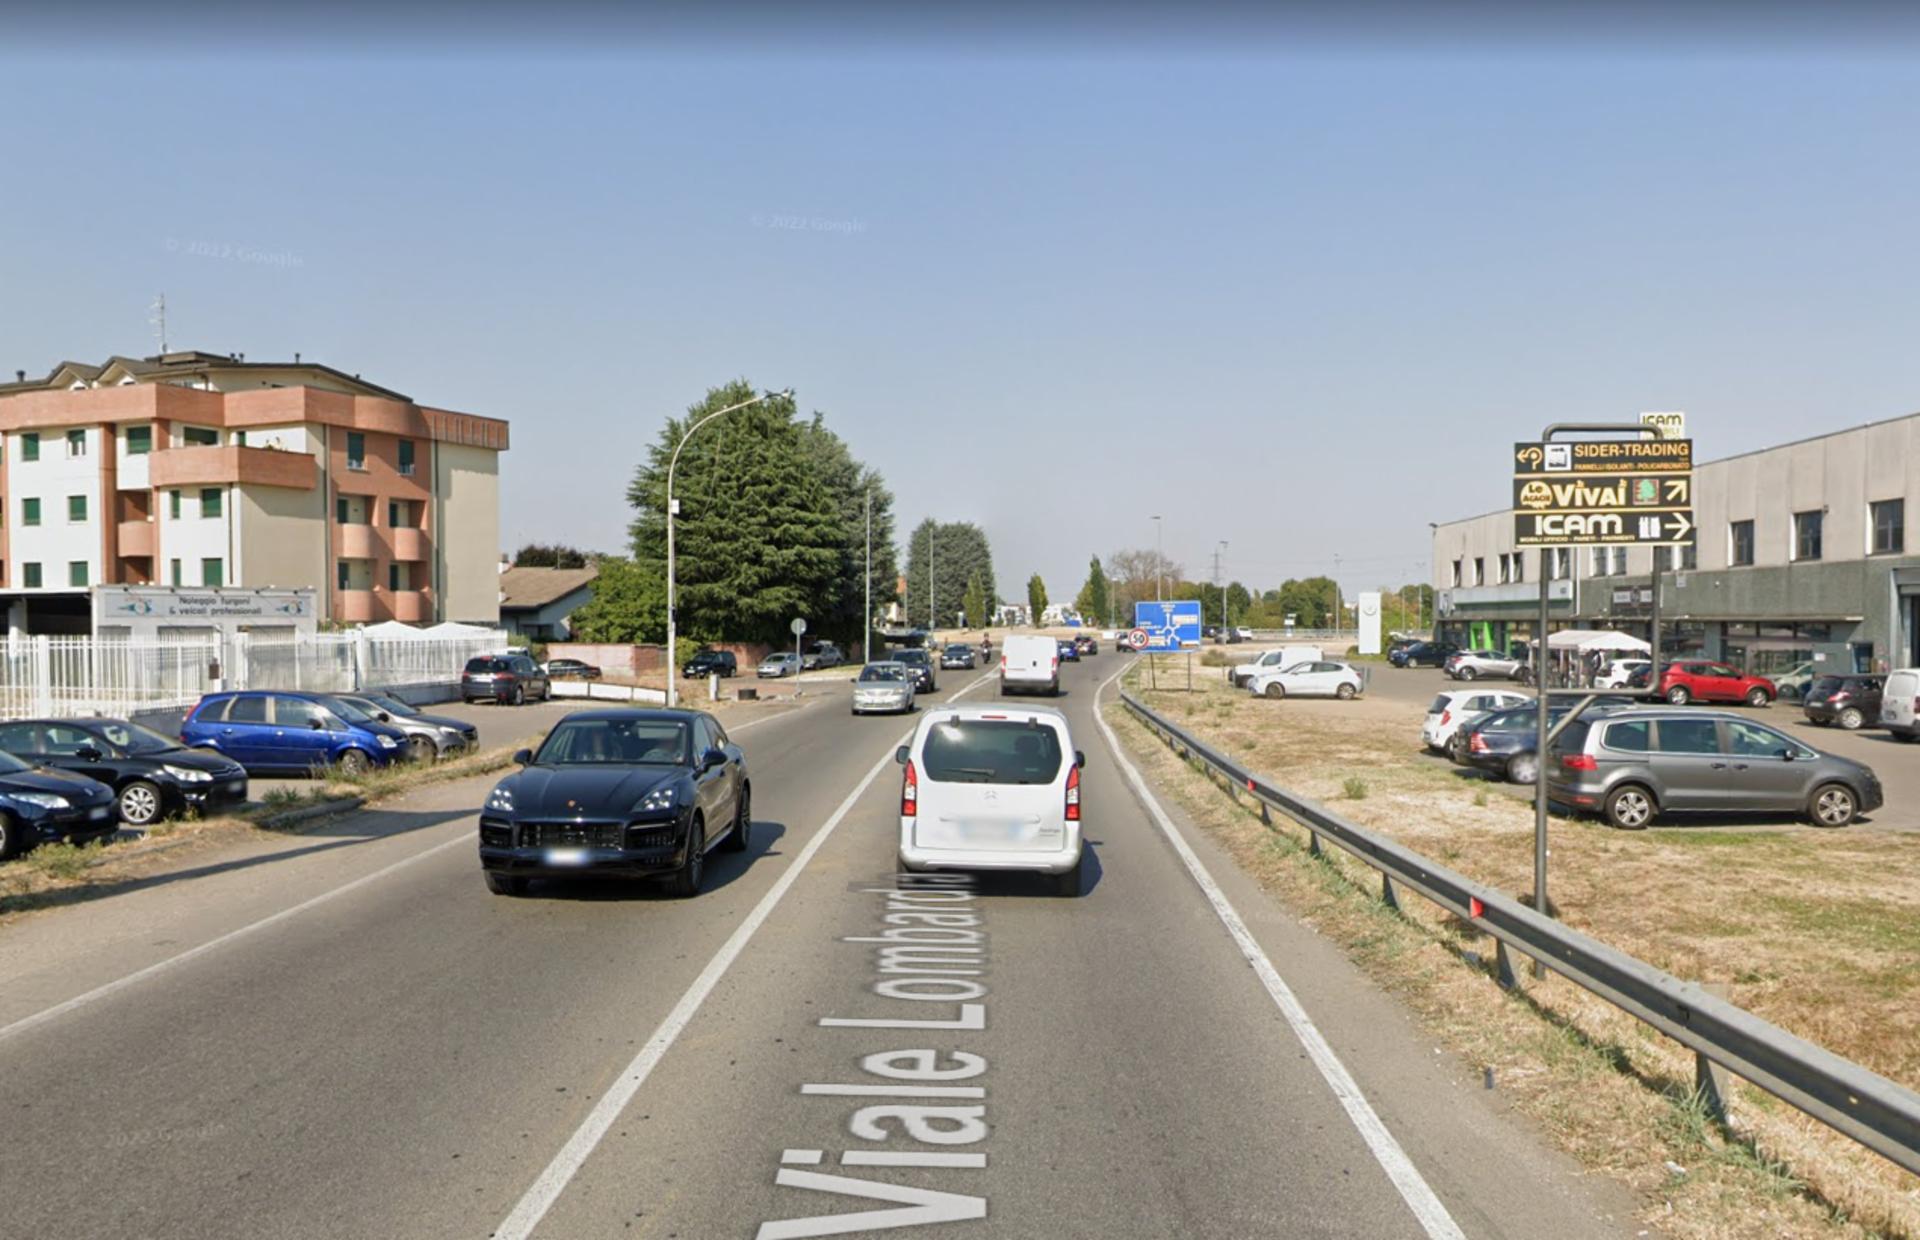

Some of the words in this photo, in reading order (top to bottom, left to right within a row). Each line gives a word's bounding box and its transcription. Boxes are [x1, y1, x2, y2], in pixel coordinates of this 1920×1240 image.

[1642, 414, 1682, 426] ICAM
[1575, 443, 1689, 457] SIDER-TRADING
[1637, 462, 1690, 471] POLICARBONATO
[1535, 514, 1622, 535] ICAM
[179, 597, 216, 605] Noleggio
[221, 596, 250, 605] furgoni
[211, 607, 261, 615] professionali
